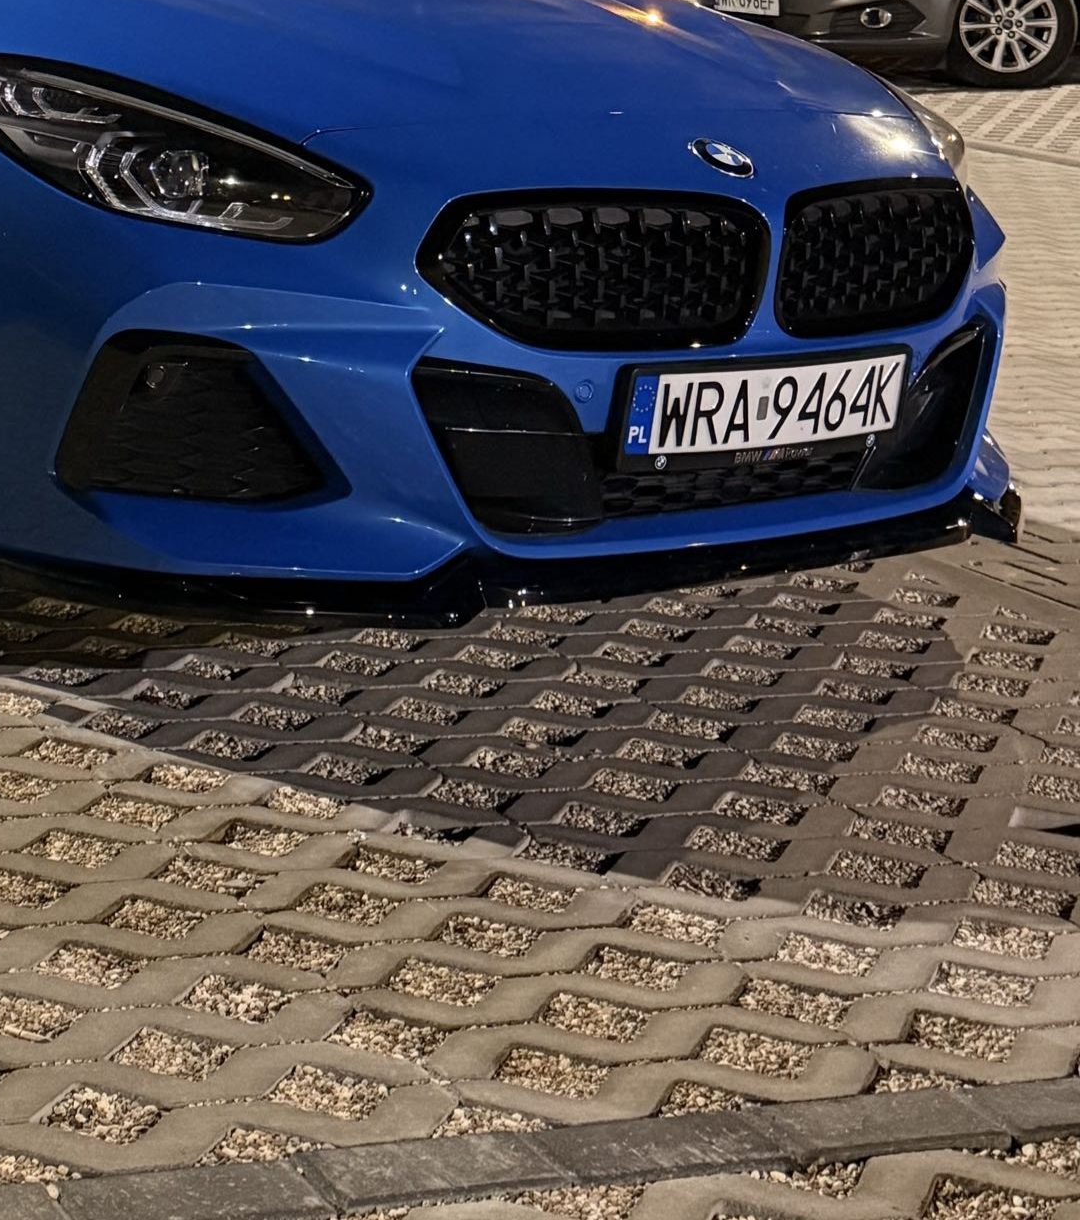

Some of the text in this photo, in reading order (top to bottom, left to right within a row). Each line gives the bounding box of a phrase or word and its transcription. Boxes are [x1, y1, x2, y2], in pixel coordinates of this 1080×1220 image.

[658, 362, 900, 448] WRA 9464K
[628, 425, 647, 444] PL
[735, 451, 762, 464] BMW
